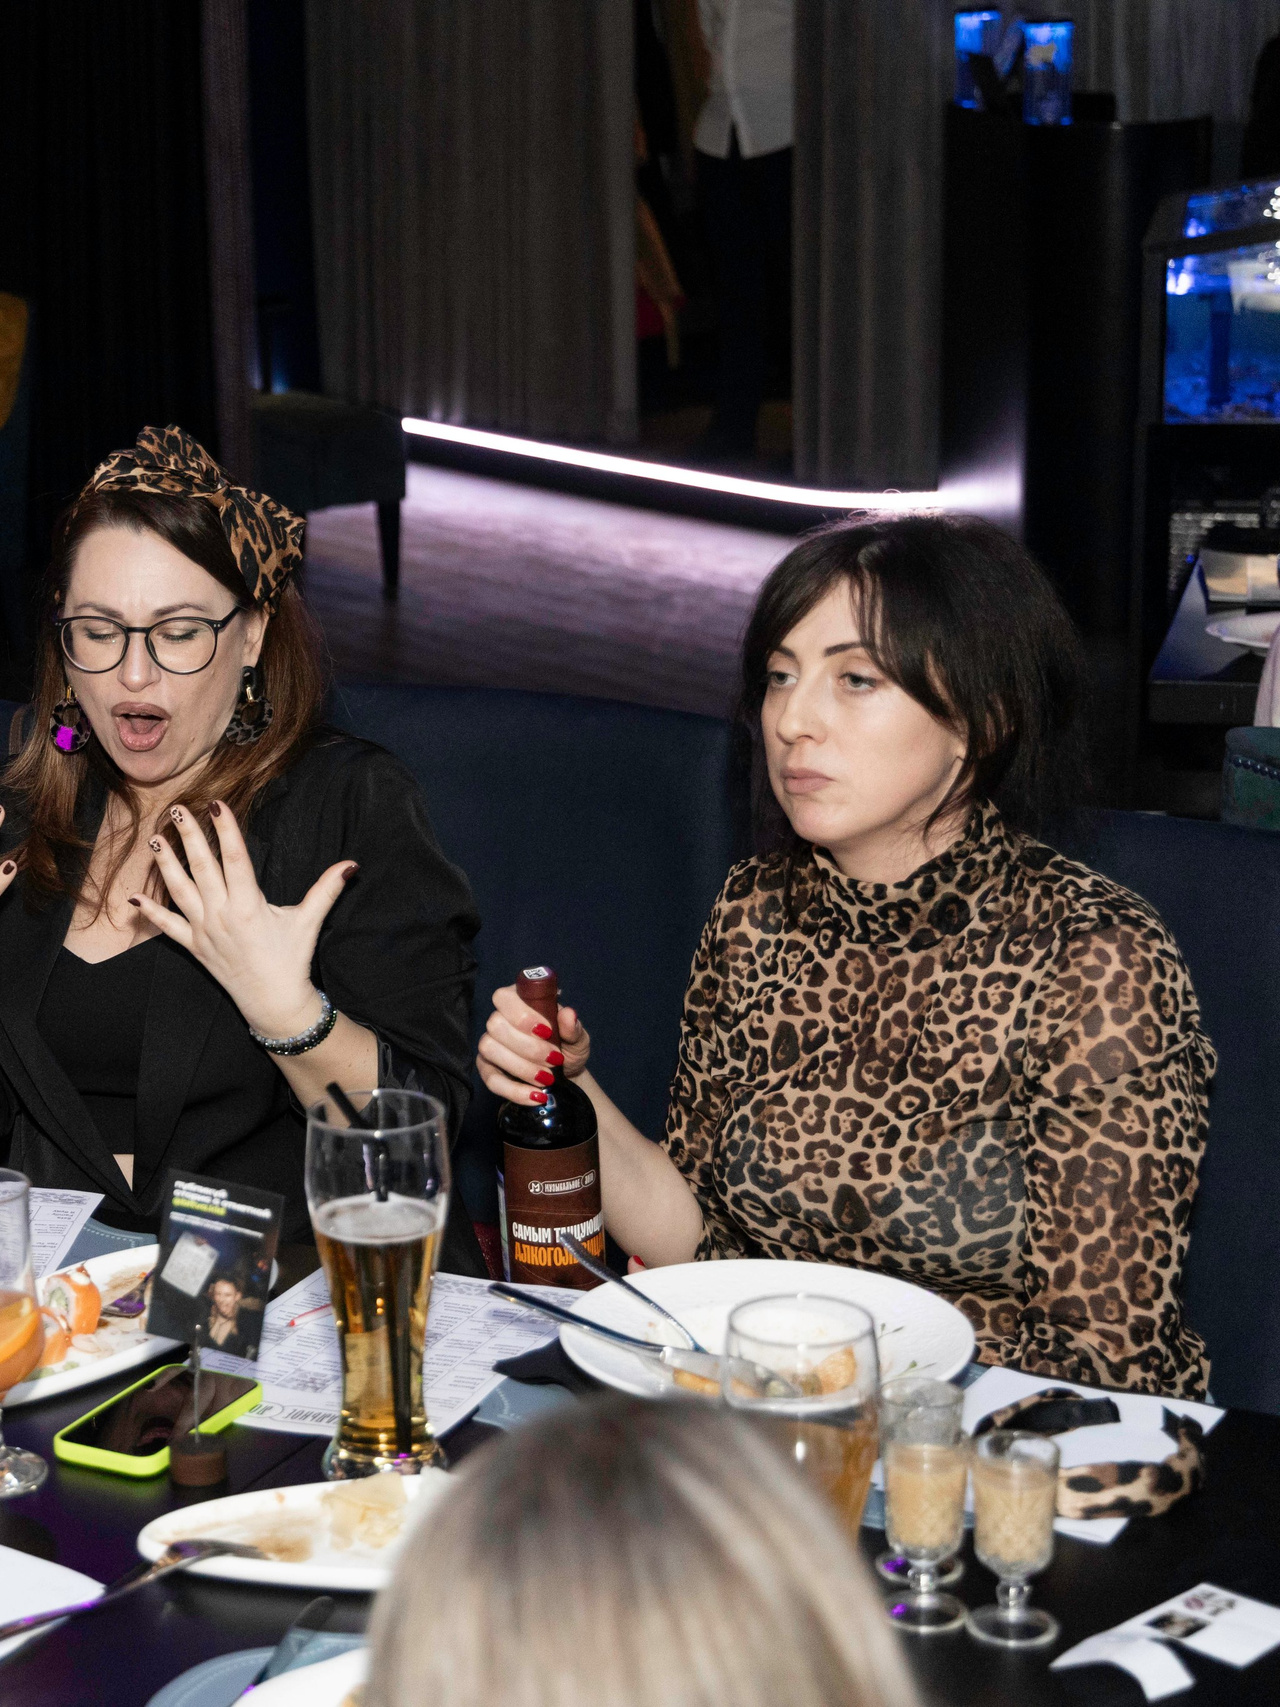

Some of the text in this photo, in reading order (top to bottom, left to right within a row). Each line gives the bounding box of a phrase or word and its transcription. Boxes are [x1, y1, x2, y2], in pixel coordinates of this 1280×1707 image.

[544, 1178, 581, 1193] МУЗЫКАЛЬНОЕ
[512, 1208, 603, 1243] САМЫМ ТЦУЮЩ
[249, 1404, 340, 1424] АЛЬНОЕ ЛО
